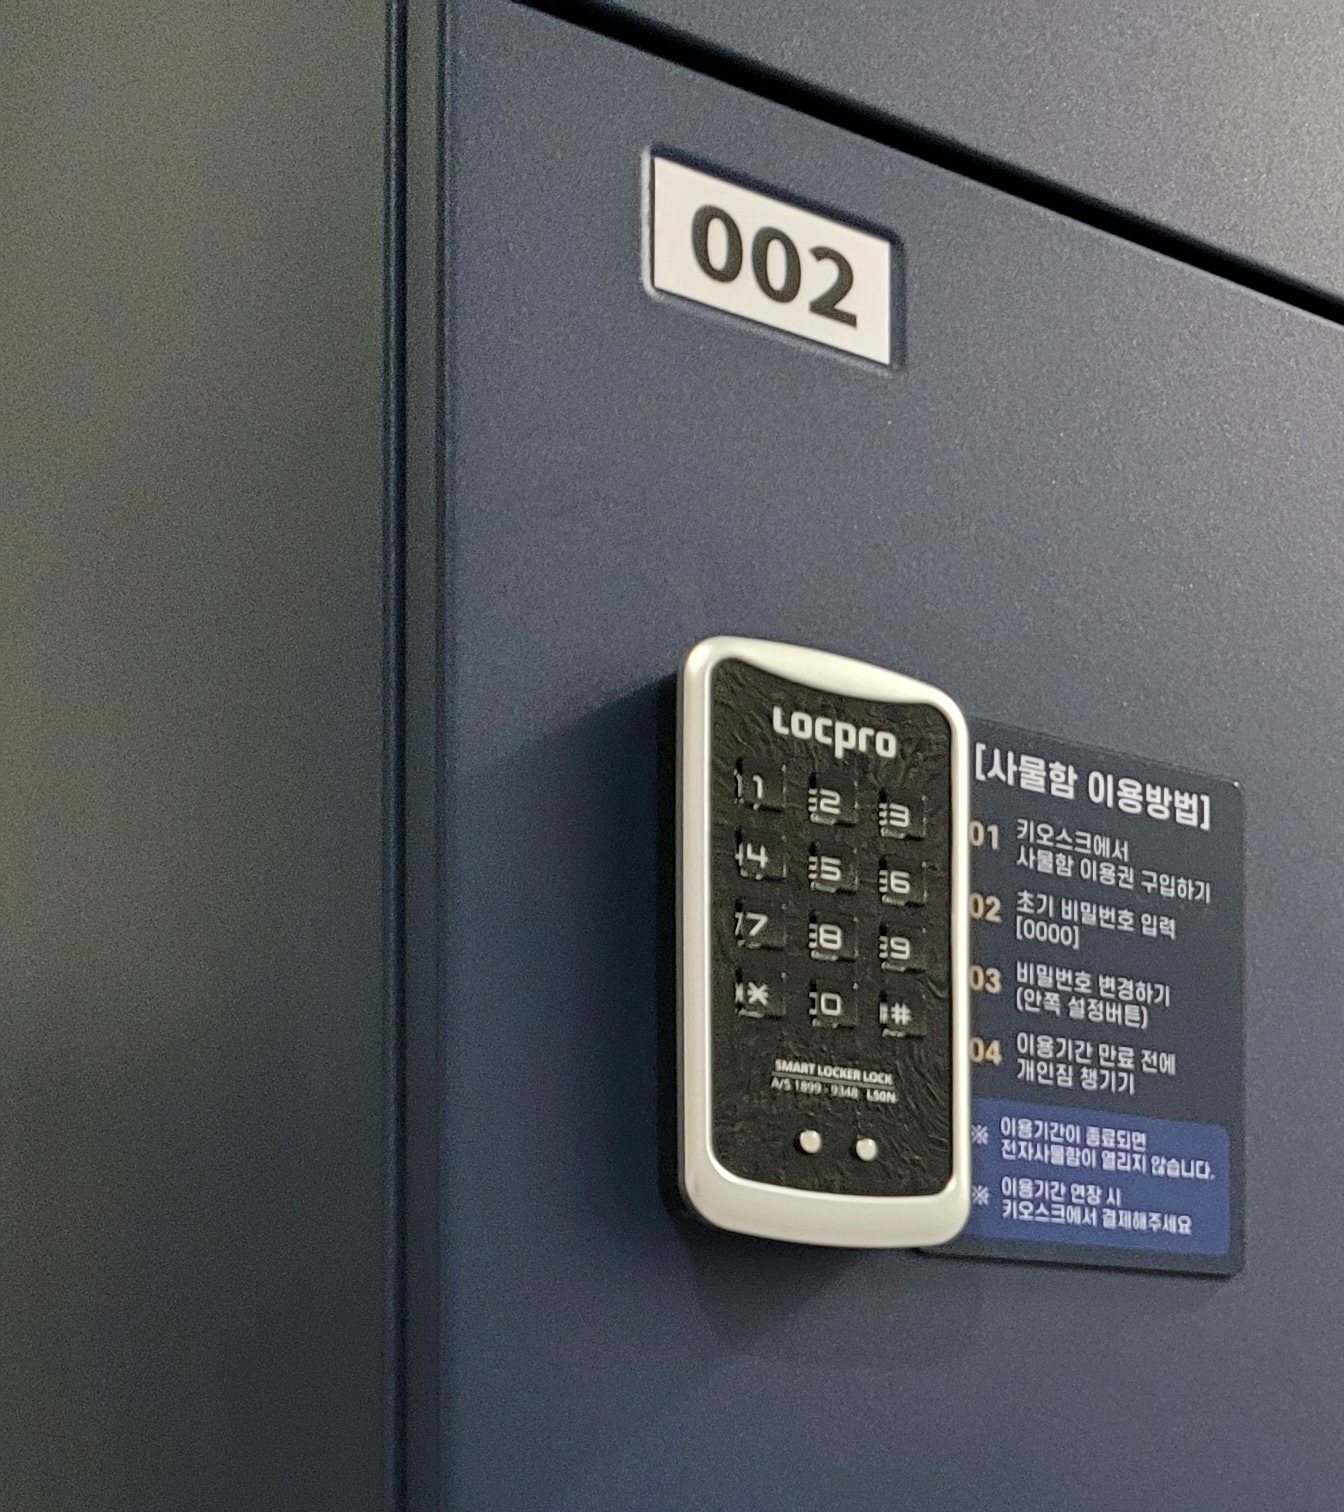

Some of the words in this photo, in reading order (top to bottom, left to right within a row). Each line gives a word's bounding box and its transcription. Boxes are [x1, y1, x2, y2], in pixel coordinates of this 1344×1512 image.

[691, 205, 857, 329] 002
[975, 742, 1078, 799] [사물함
[1088, 771, 1211, 831] 이용방법]
[968, 821, 999, 849] 01
[1017, 818, 1129, 862] 키오스크에서
[1016, 847, 1073, 877] 사물함
[1080, 858, 1134, 889] 이용권
[1141, 871, 1211, 904] 구입하기
[968, 893, 1001, 923] 02
[1016, 890, 1053, 918] 초기
[1061, 899, 1134, 932] 비밀번호
[1141, 914, 1176, 940] 입력
[1016, 919, 1080, 950] [0000]
[968, 965, 1001, 994] 03
[1016, 961, 1092, 994] 비밀번호
[1099, 973, 1170, 1007] 변경하기
[1016, 987, 1061, 1016] (안쪽
[1068, 999, 1148, 1029] 설정버튼)
[775, 1059, 815, 1075] SMART
[817, 1064, 861, 1081] LOCKER
[863, 1070, 893, 1085] LOCK
[969, 1038, 1002, 1066] 04
[1016, 1032, 1092, 1063] 이용기간
[1099, 1043, 1135, 1070] 만료
[1141, 1050, 1176, 1076] 전에
[1017, 1059, 1073, 1087] 개인짐
[1080, 1067, 1135, 1095] 챙기기
[1001, 1116, 1081, 1143] 이용기간이
[1086, 1126, 1147, 1152] 종료되면
[1001, 1140, 1097, 1168] 전자사물함이
[1101, 1152, 1147, 1173] 열리지
[1151, 1155, 1215, 1180] 않습니다.
[1001, 1177, 1066, 1201] 이용기간
[1071, 1184, 1102, 1205] 연장
[1107, 1188, 1121, 1207] 시
[1001, 1200, 1097, 1226] 키오스크에서
[1102, 1208, 1192, 1235] 결제해주세요
